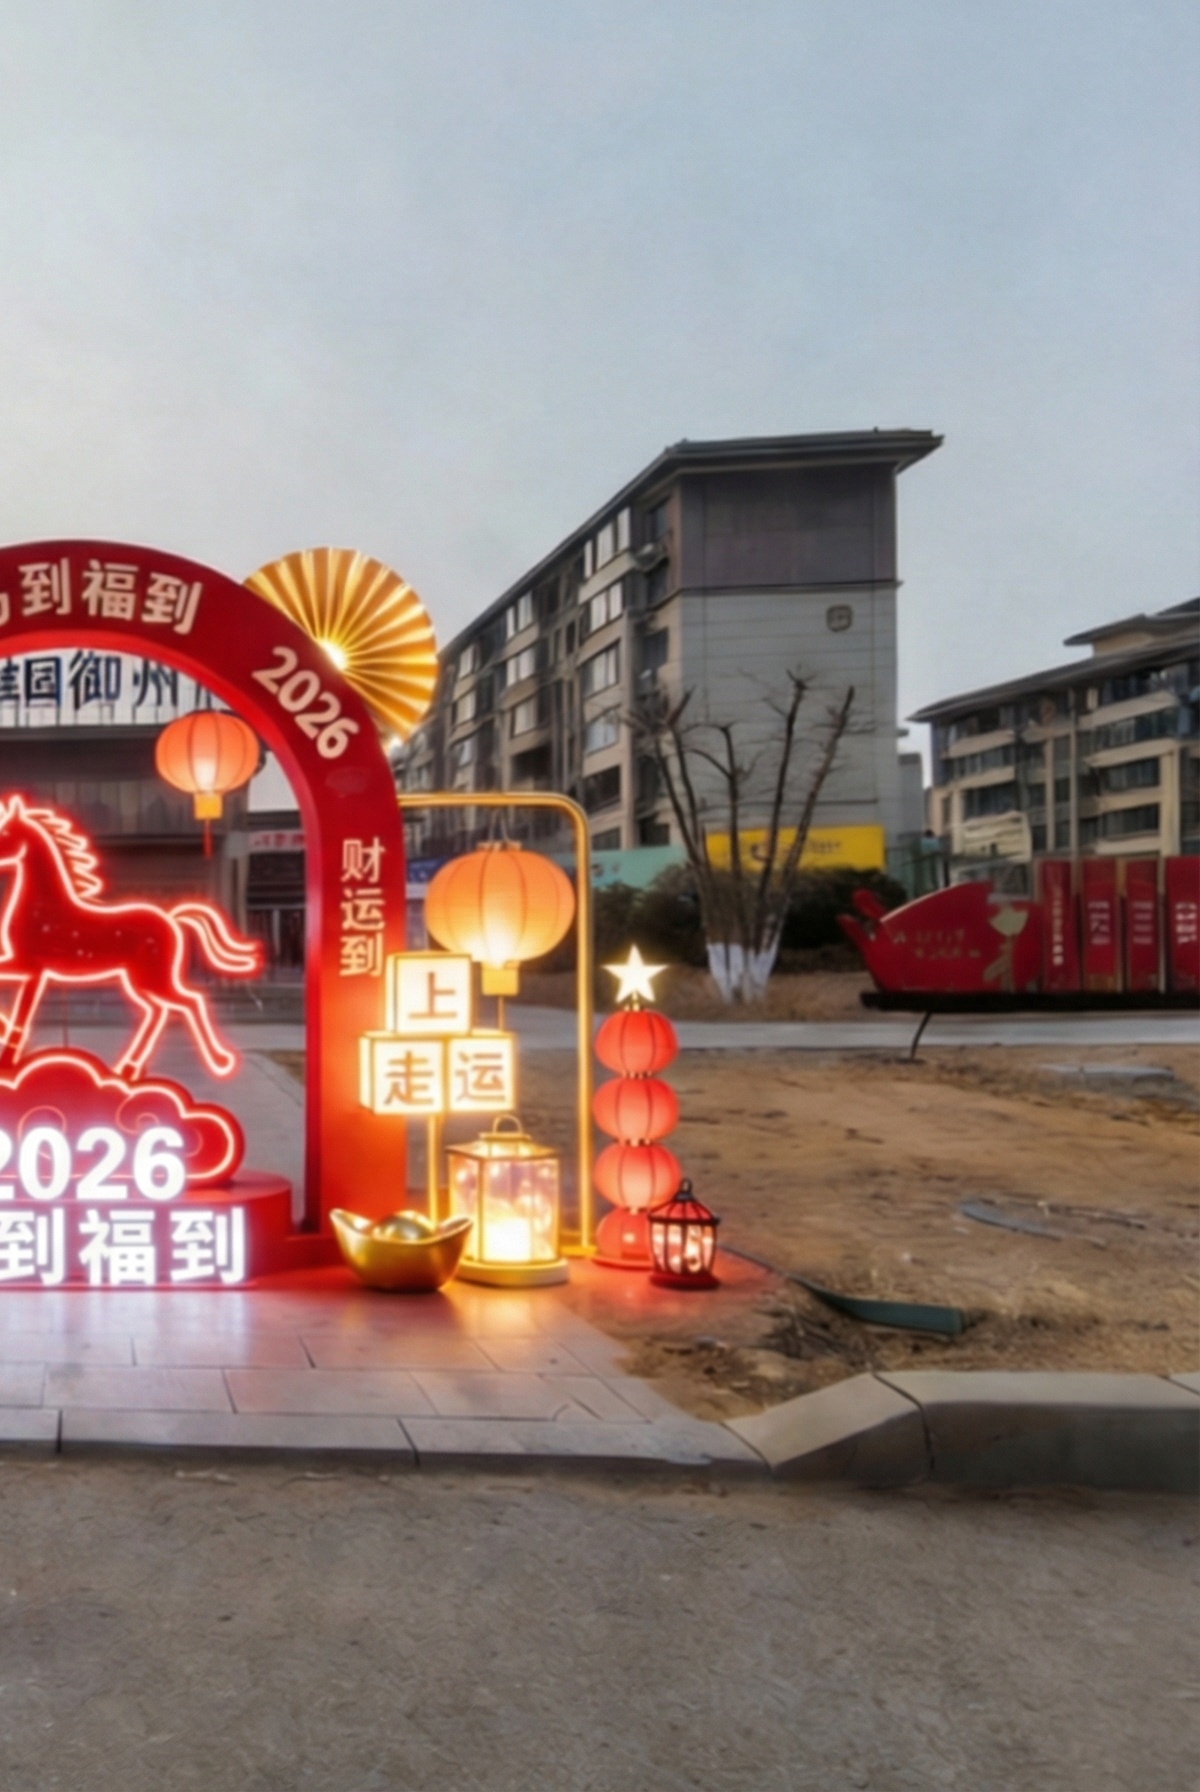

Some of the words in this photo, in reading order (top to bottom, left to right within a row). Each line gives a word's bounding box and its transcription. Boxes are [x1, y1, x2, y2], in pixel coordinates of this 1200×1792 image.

[251, 646, 359, 759] 2026
[340, 837, 386, 977] 财运到
[407, 971, 458, 1020] 上
[384, 1050, 506, 1105] 走运
